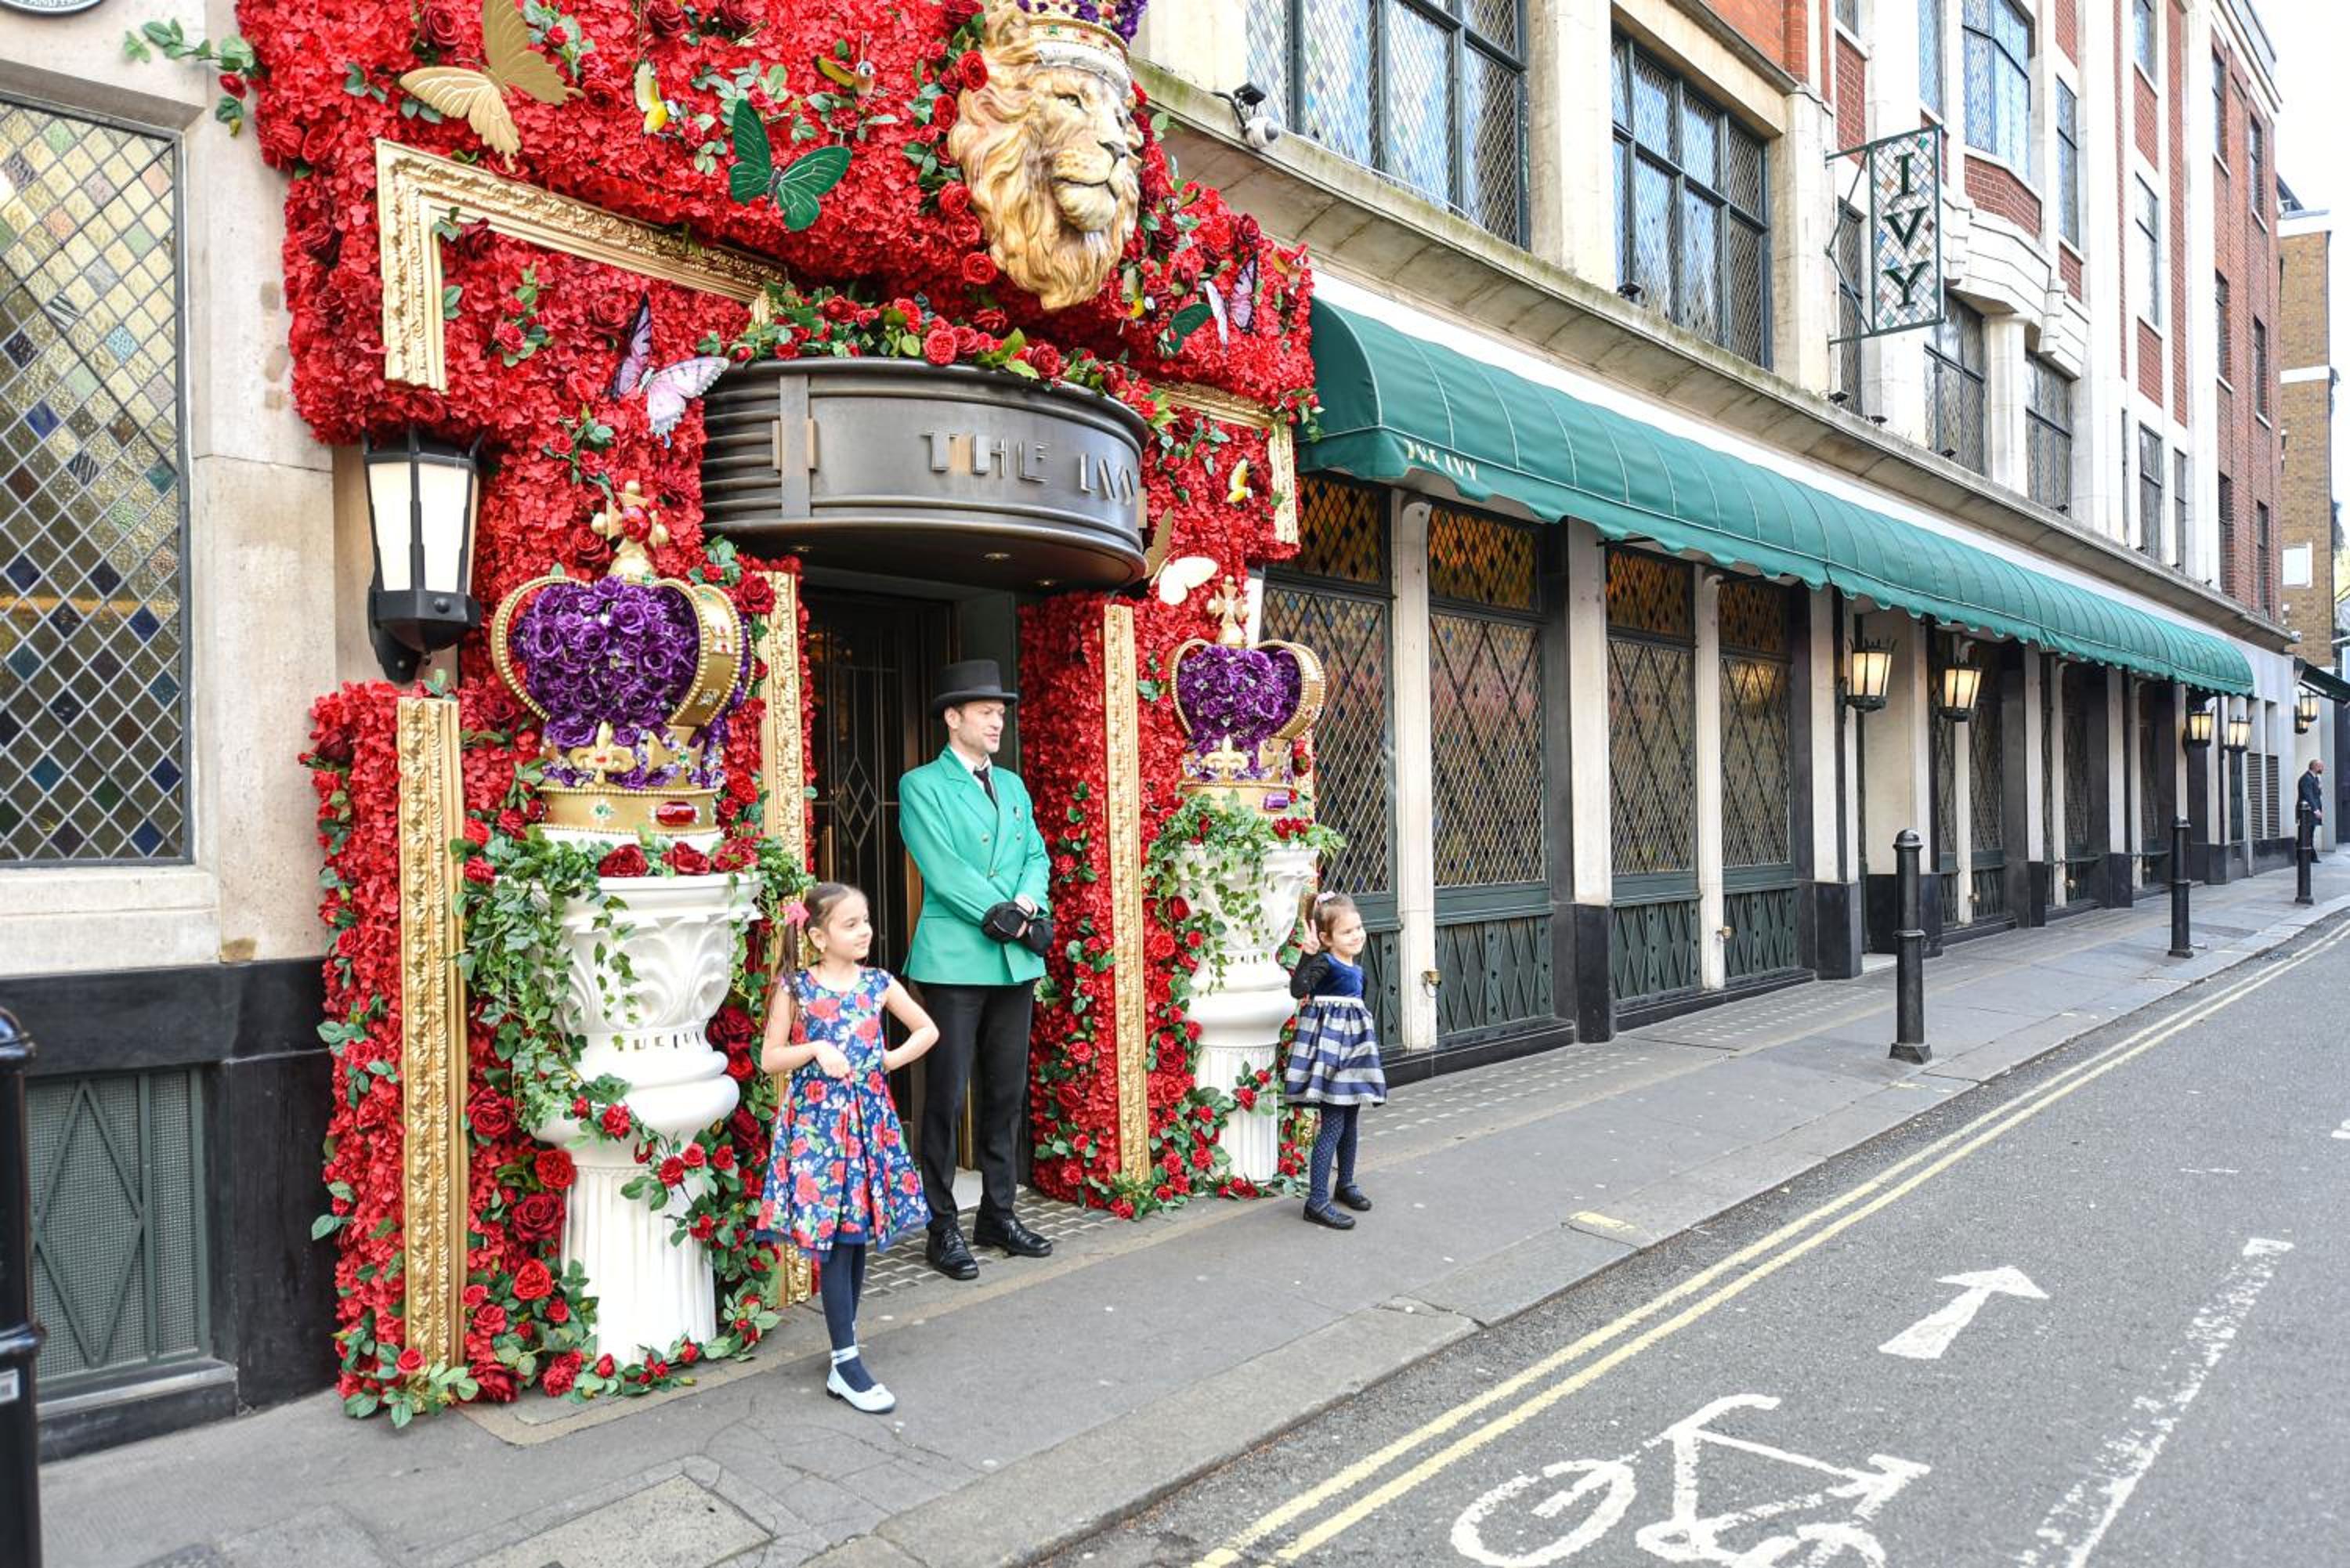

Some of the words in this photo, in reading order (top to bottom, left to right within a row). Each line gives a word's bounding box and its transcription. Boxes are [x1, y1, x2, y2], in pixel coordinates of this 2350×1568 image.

[1882, 153, 1930, 308] IVY
[920, 431, 1050, 482] THE
[1444, 453, 1477, 482] IVY
